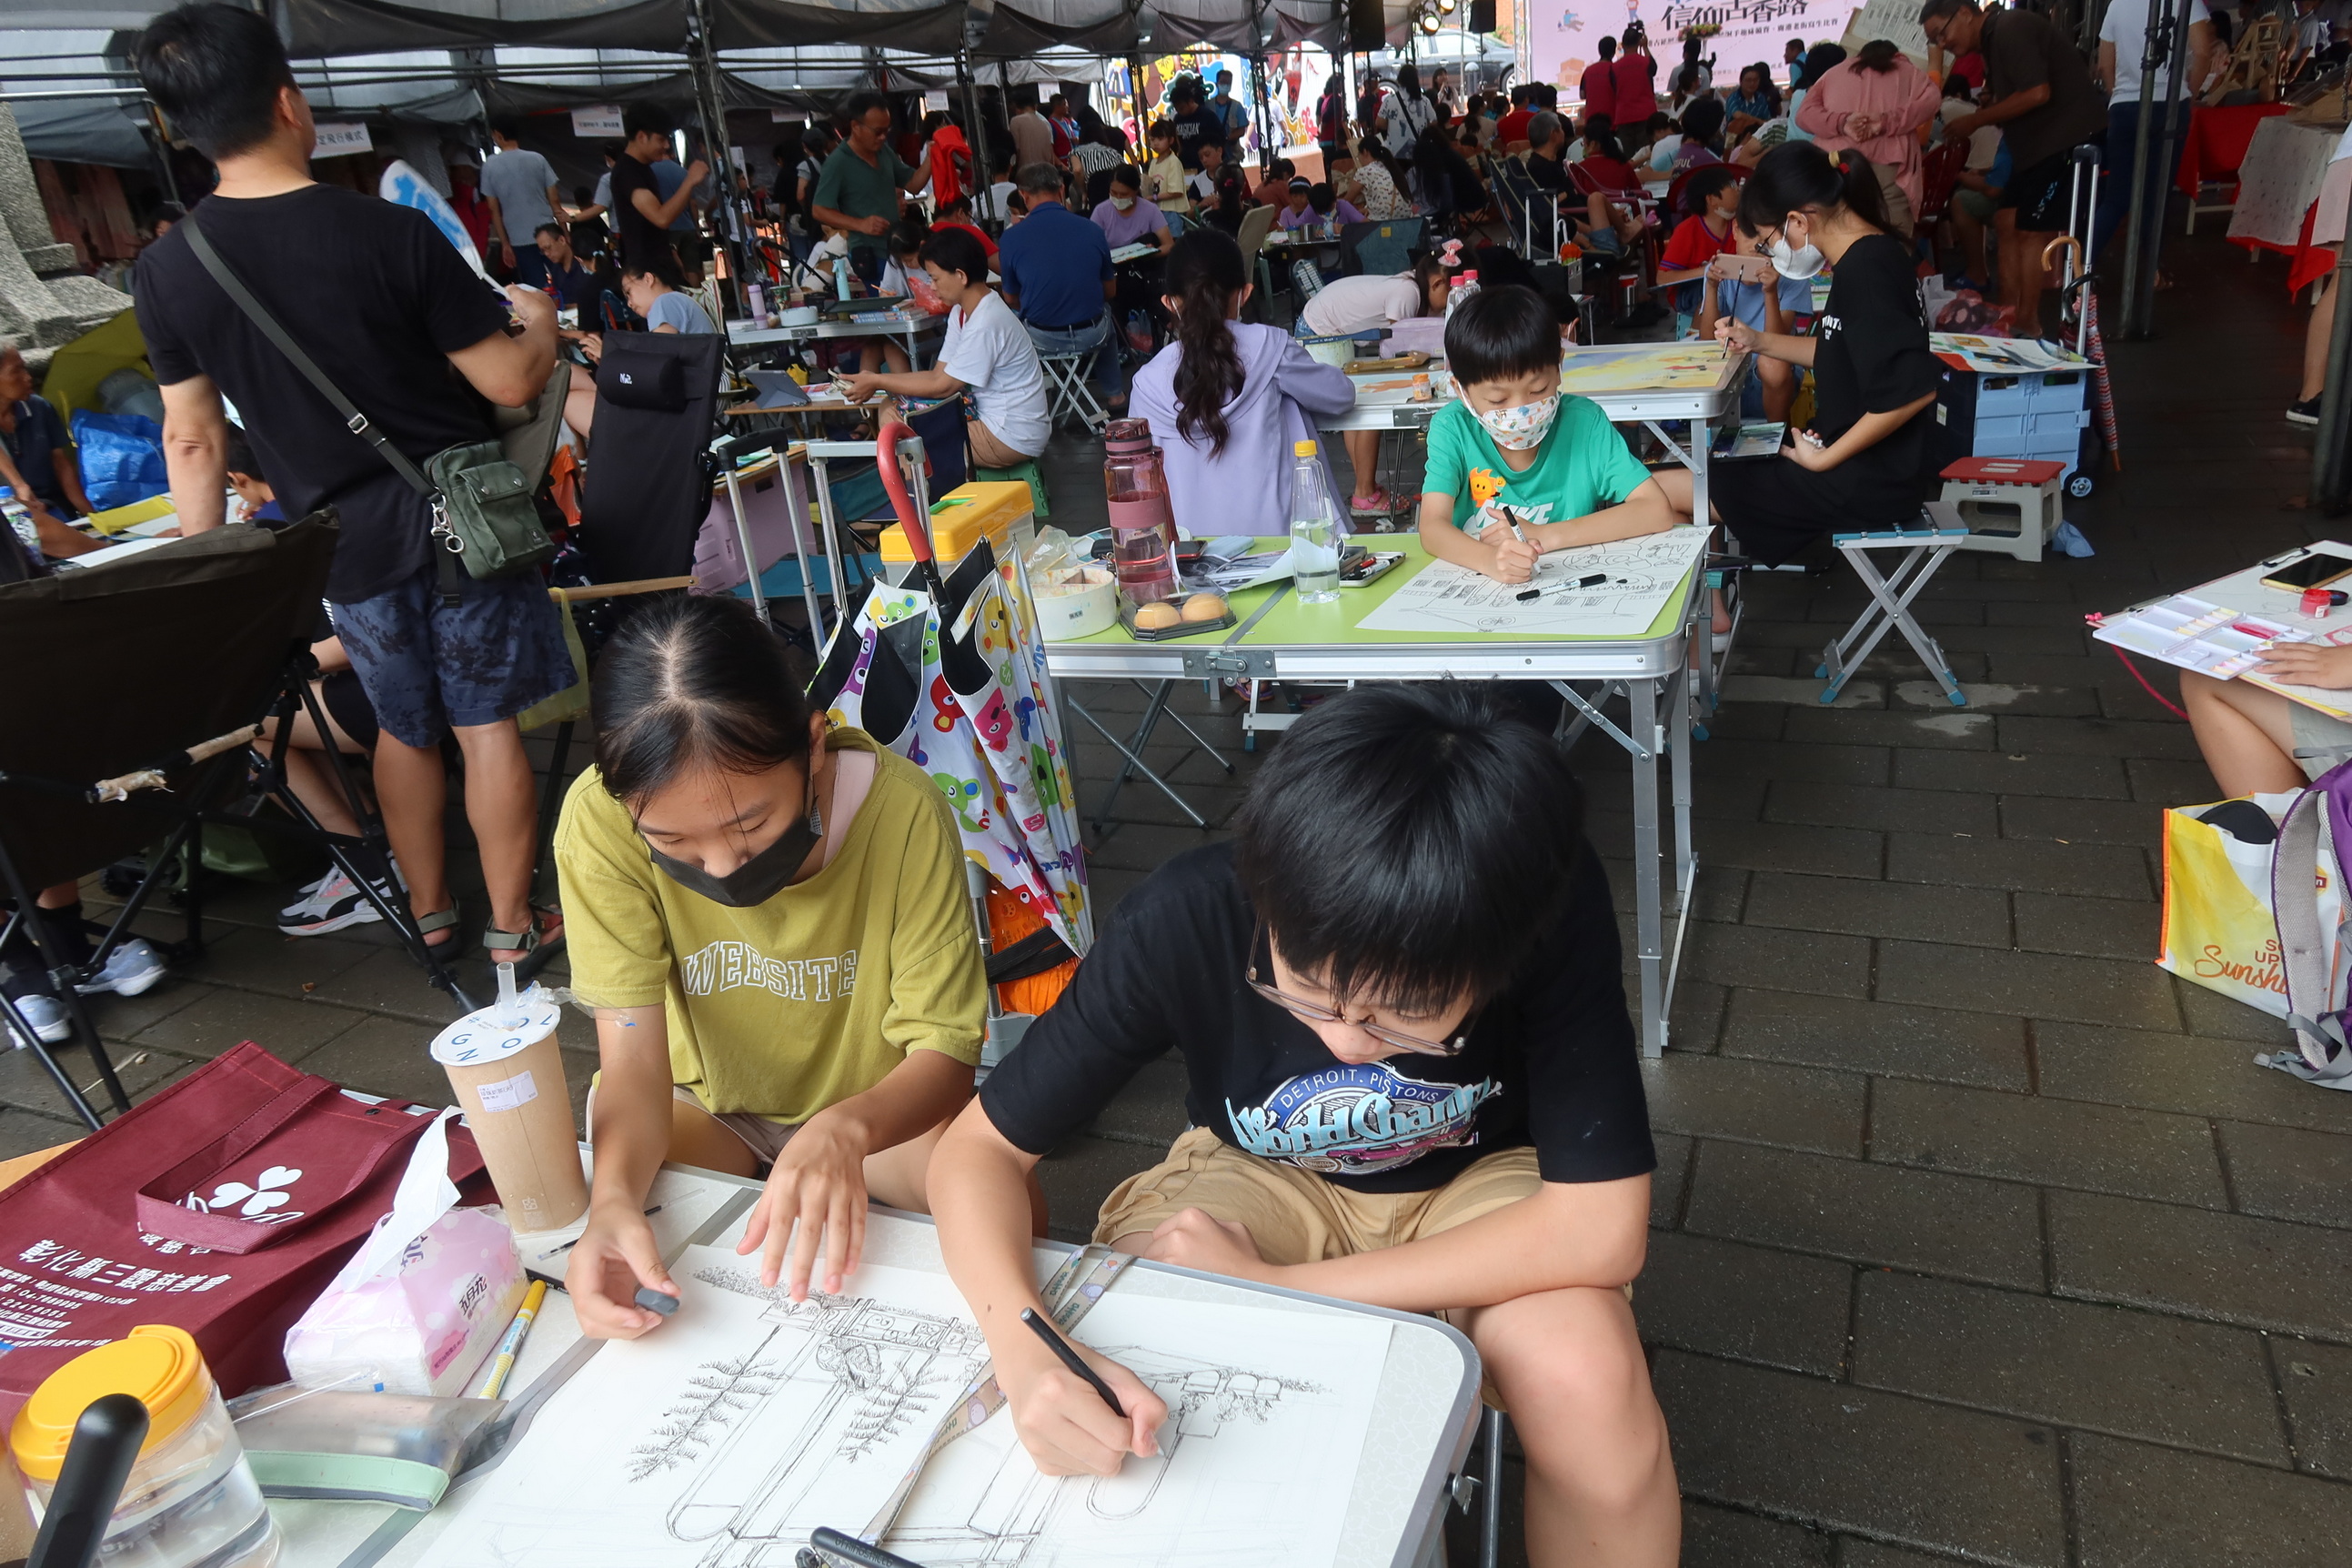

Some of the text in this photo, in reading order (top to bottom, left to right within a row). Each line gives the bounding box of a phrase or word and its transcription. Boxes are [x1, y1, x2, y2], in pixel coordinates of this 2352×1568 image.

[682, 940, 857, 1002] WEBSITE
[458, 1276, 487, 1316] 五月花
